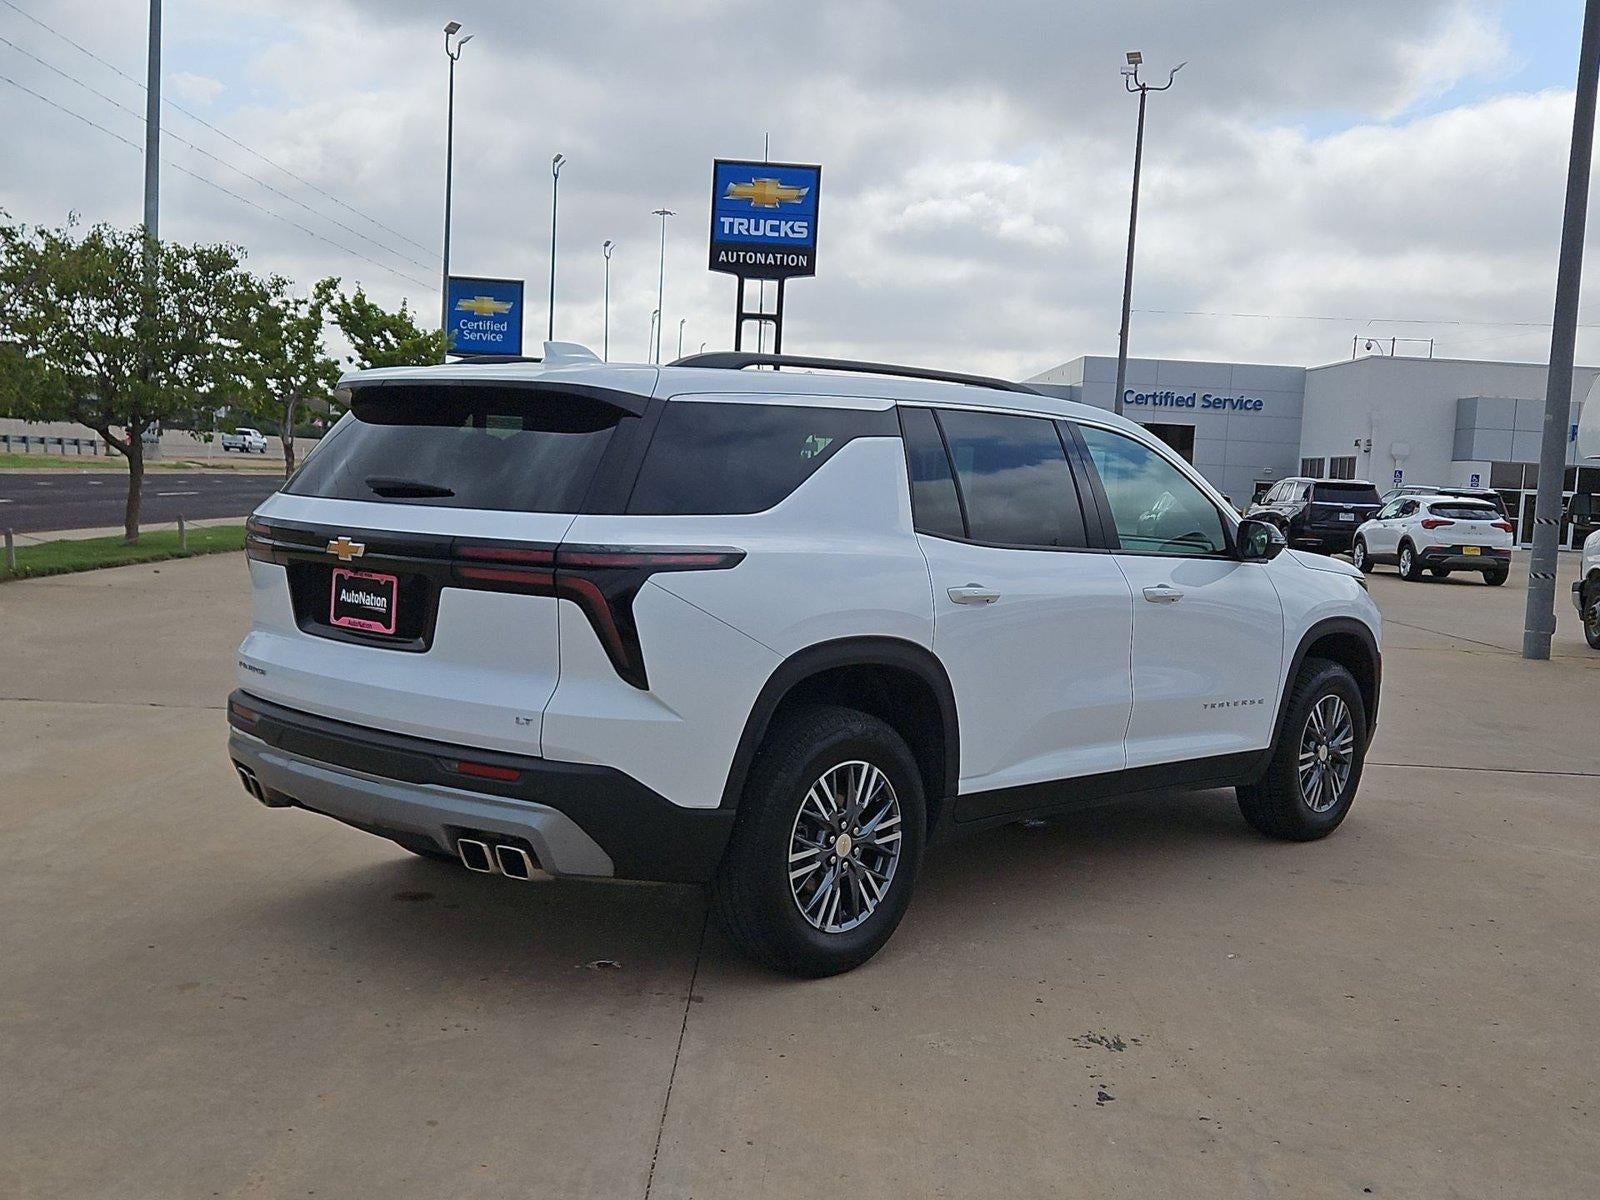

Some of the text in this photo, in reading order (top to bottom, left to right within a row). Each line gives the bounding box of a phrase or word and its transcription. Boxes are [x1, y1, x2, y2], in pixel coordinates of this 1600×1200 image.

[720, 216, 808, 238] TRUCKS
[718, 250, 808, 267] AUTONATION
[459, 319, 507, 331] Certified
[463, 329, 503, 341] Service
[1123, 389, 1264, 411] Certified Service
[340, 588, 387, 608] AutoNation
